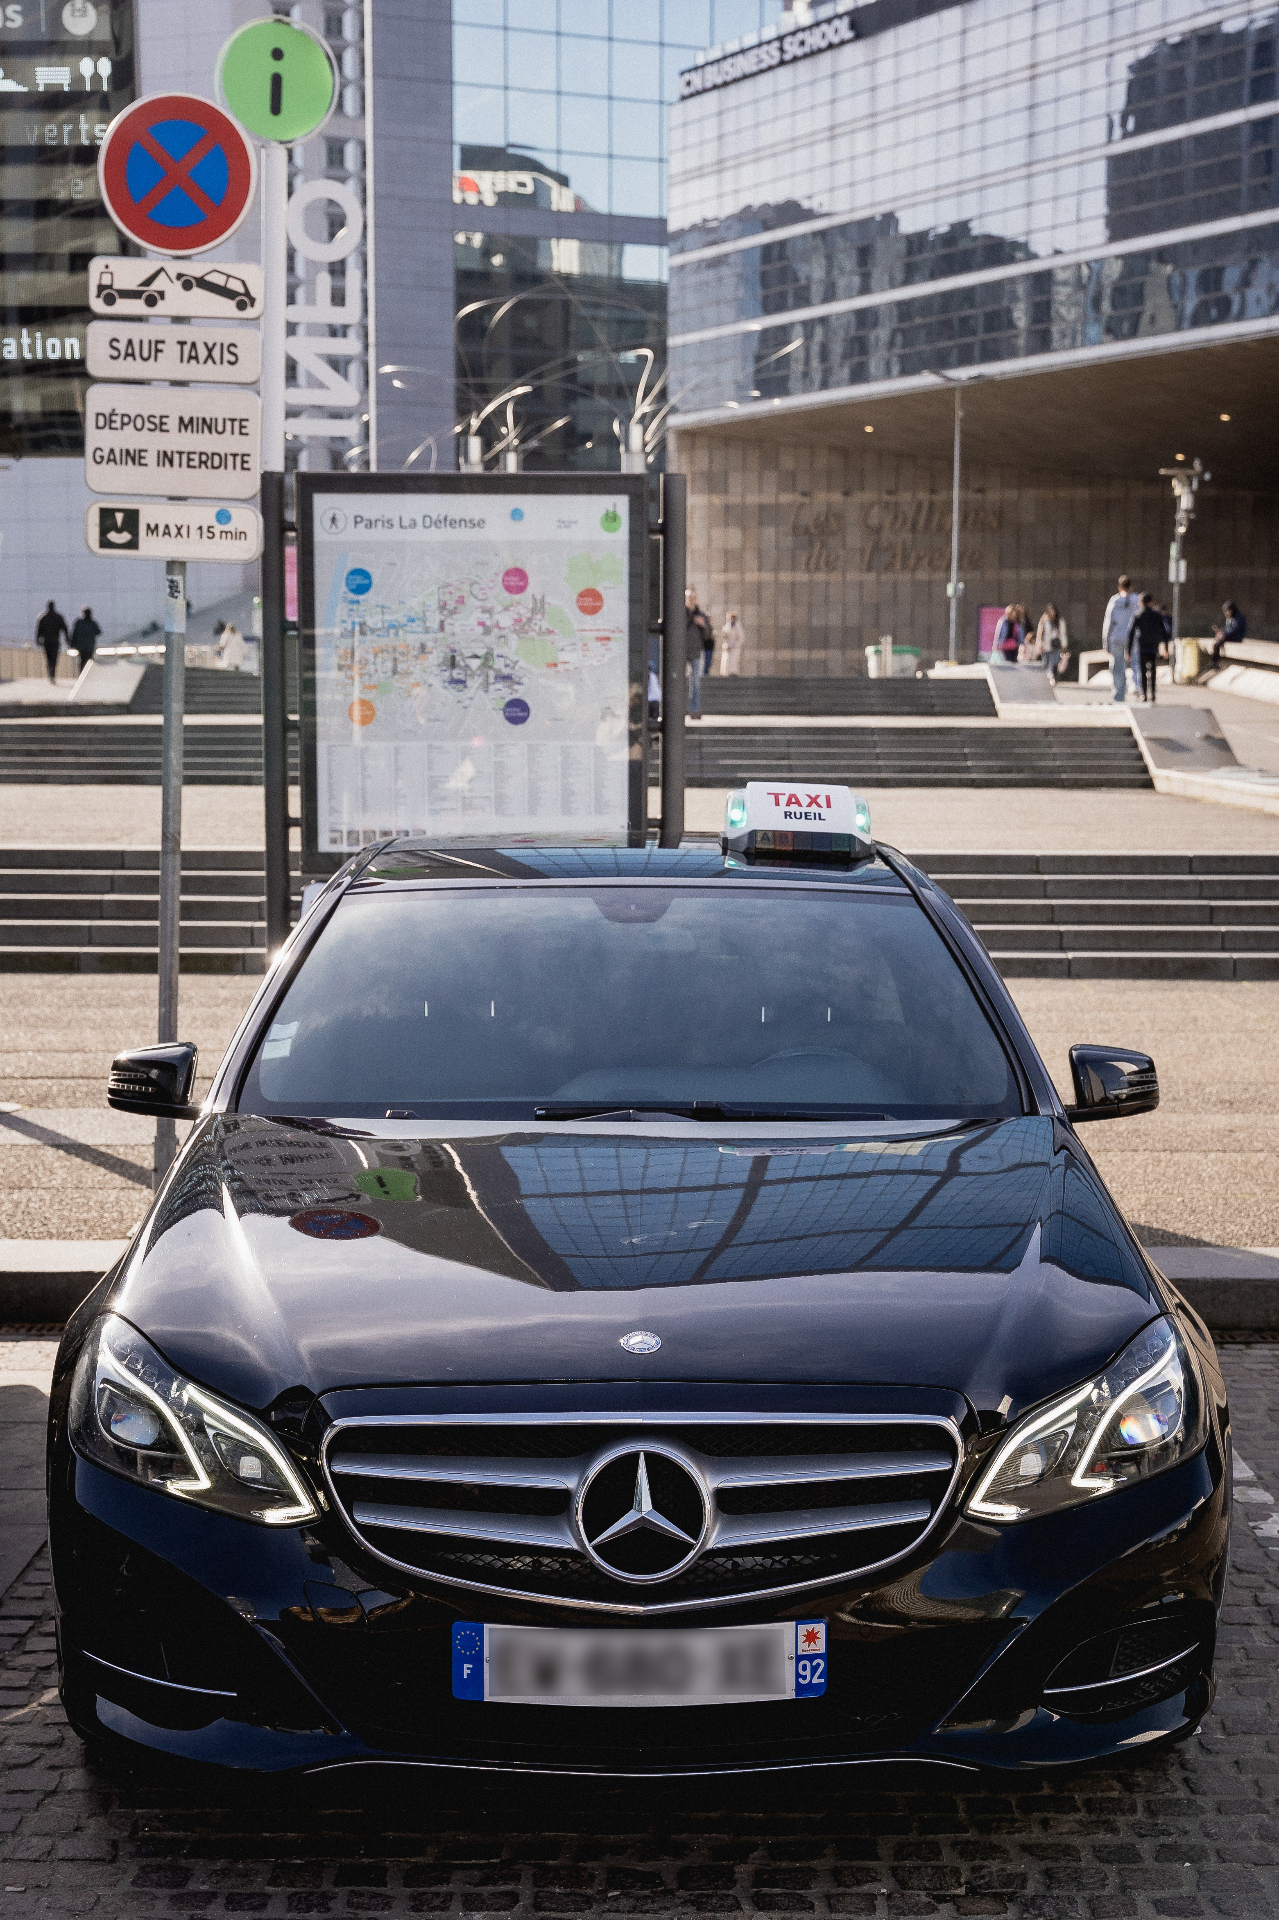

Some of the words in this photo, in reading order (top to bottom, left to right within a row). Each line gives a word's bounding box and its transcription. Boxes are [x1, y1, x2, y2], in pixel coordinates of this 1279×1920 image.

[782, 15, 855, 61] SCHOOL
[109, 337, 166, 362] SAUF
[176, 340, 239, 366] TAXIS
[95, 408, 170, 433] DÉPOSE
[178, 416, 250, 436] MINUTE
[92, 447, 148, 467] GAINE
[156, 450, 251, 471] INTERDITE
[146, 523, 190, 539] MAXI
[197, 525, 216, 540] 15
[219, 528, 247, 541] min
[353, 514, 395, 530] Paris
[399, 514, 417, 530] La
[422, 513, 487, 530] Défense
[767, 792, 832, 809] TAXI
[783, 810, 826, 821] RUEIL
[463, 1664, 473, 1679] F
[798, 1658, 825, 1685] 92
